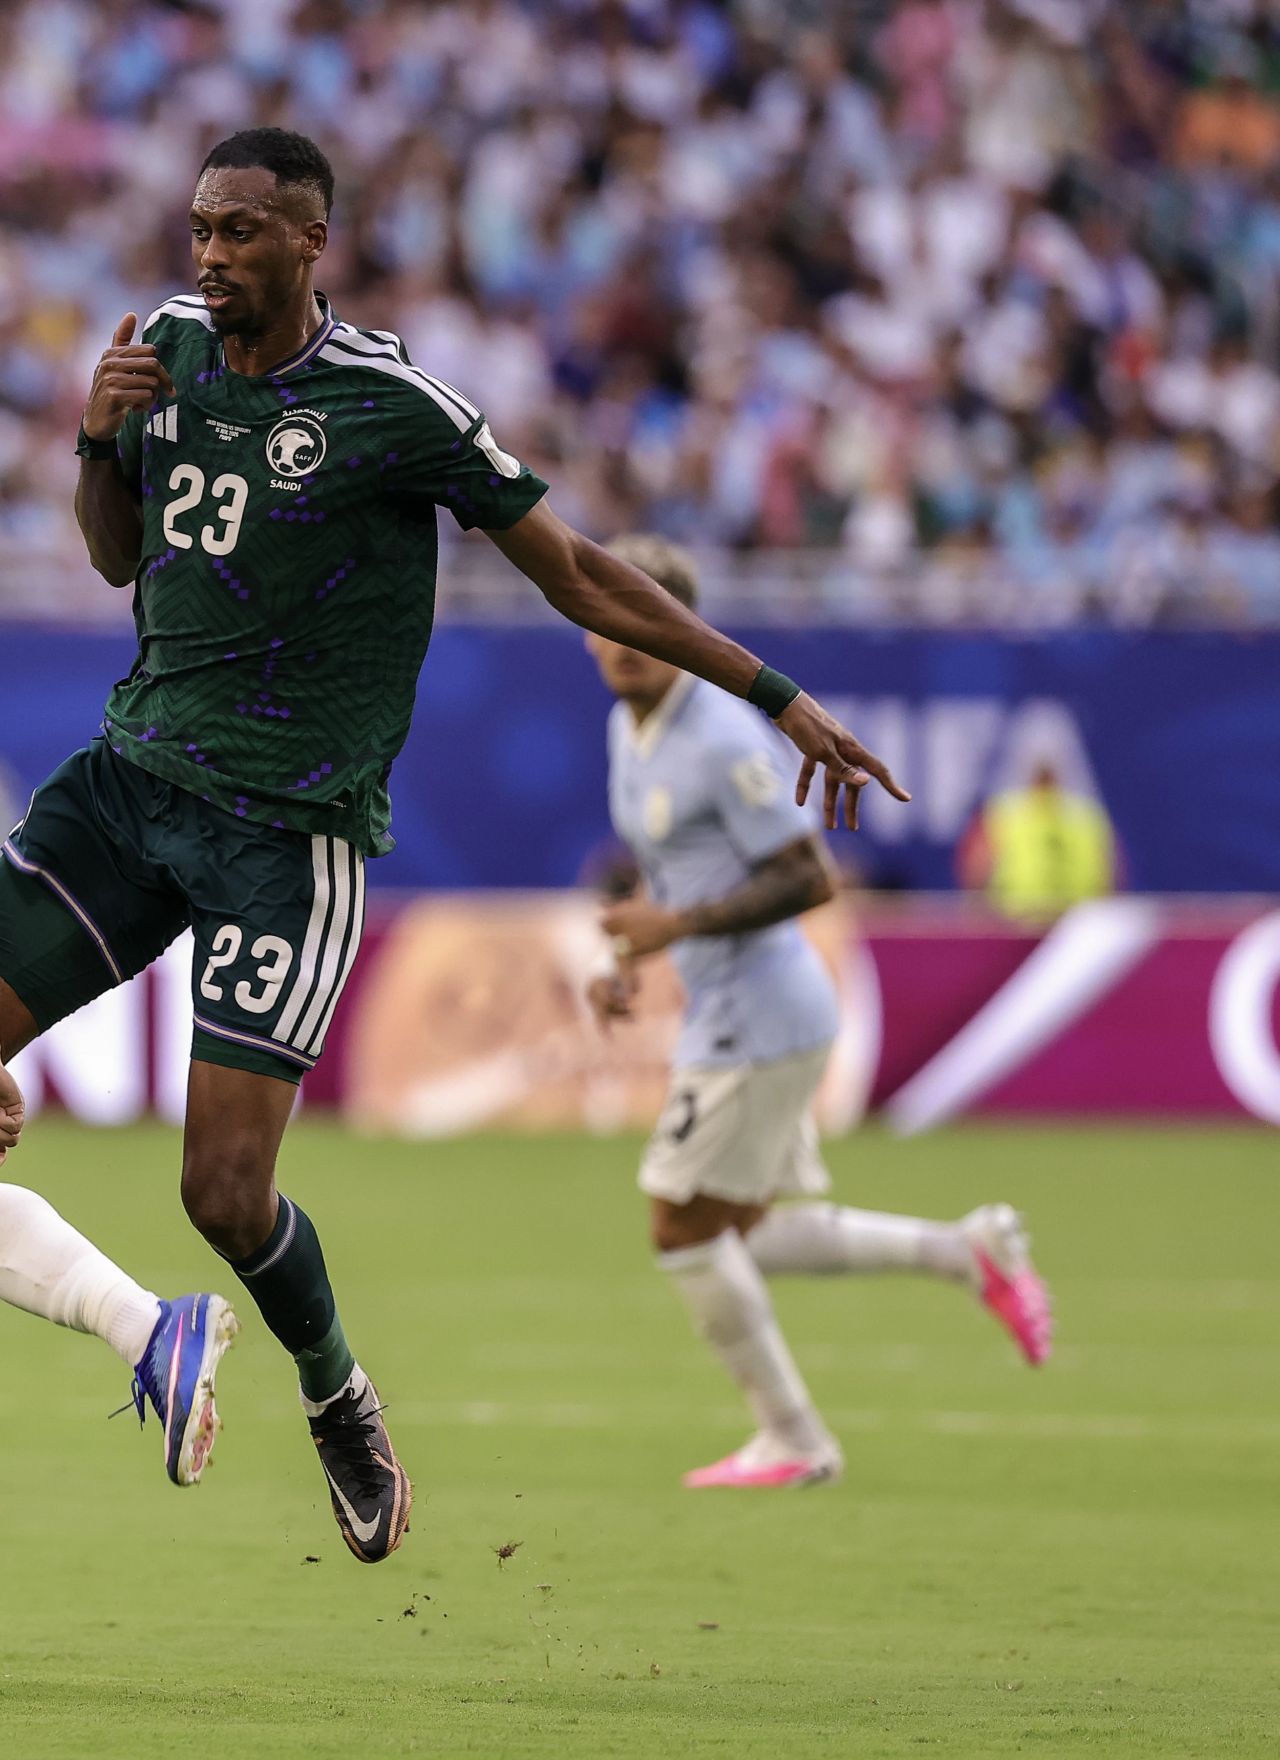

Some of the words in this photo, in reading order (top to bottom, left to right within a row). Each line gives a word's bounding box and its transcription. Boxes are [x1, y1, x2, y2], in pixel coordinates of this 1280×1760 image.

[294, 453, 312, 462] SAFF
[163, 463, 249, 556] 23
[269, 479, 302, 492] SAUDI
[200, 924, 293, 1014] 23
